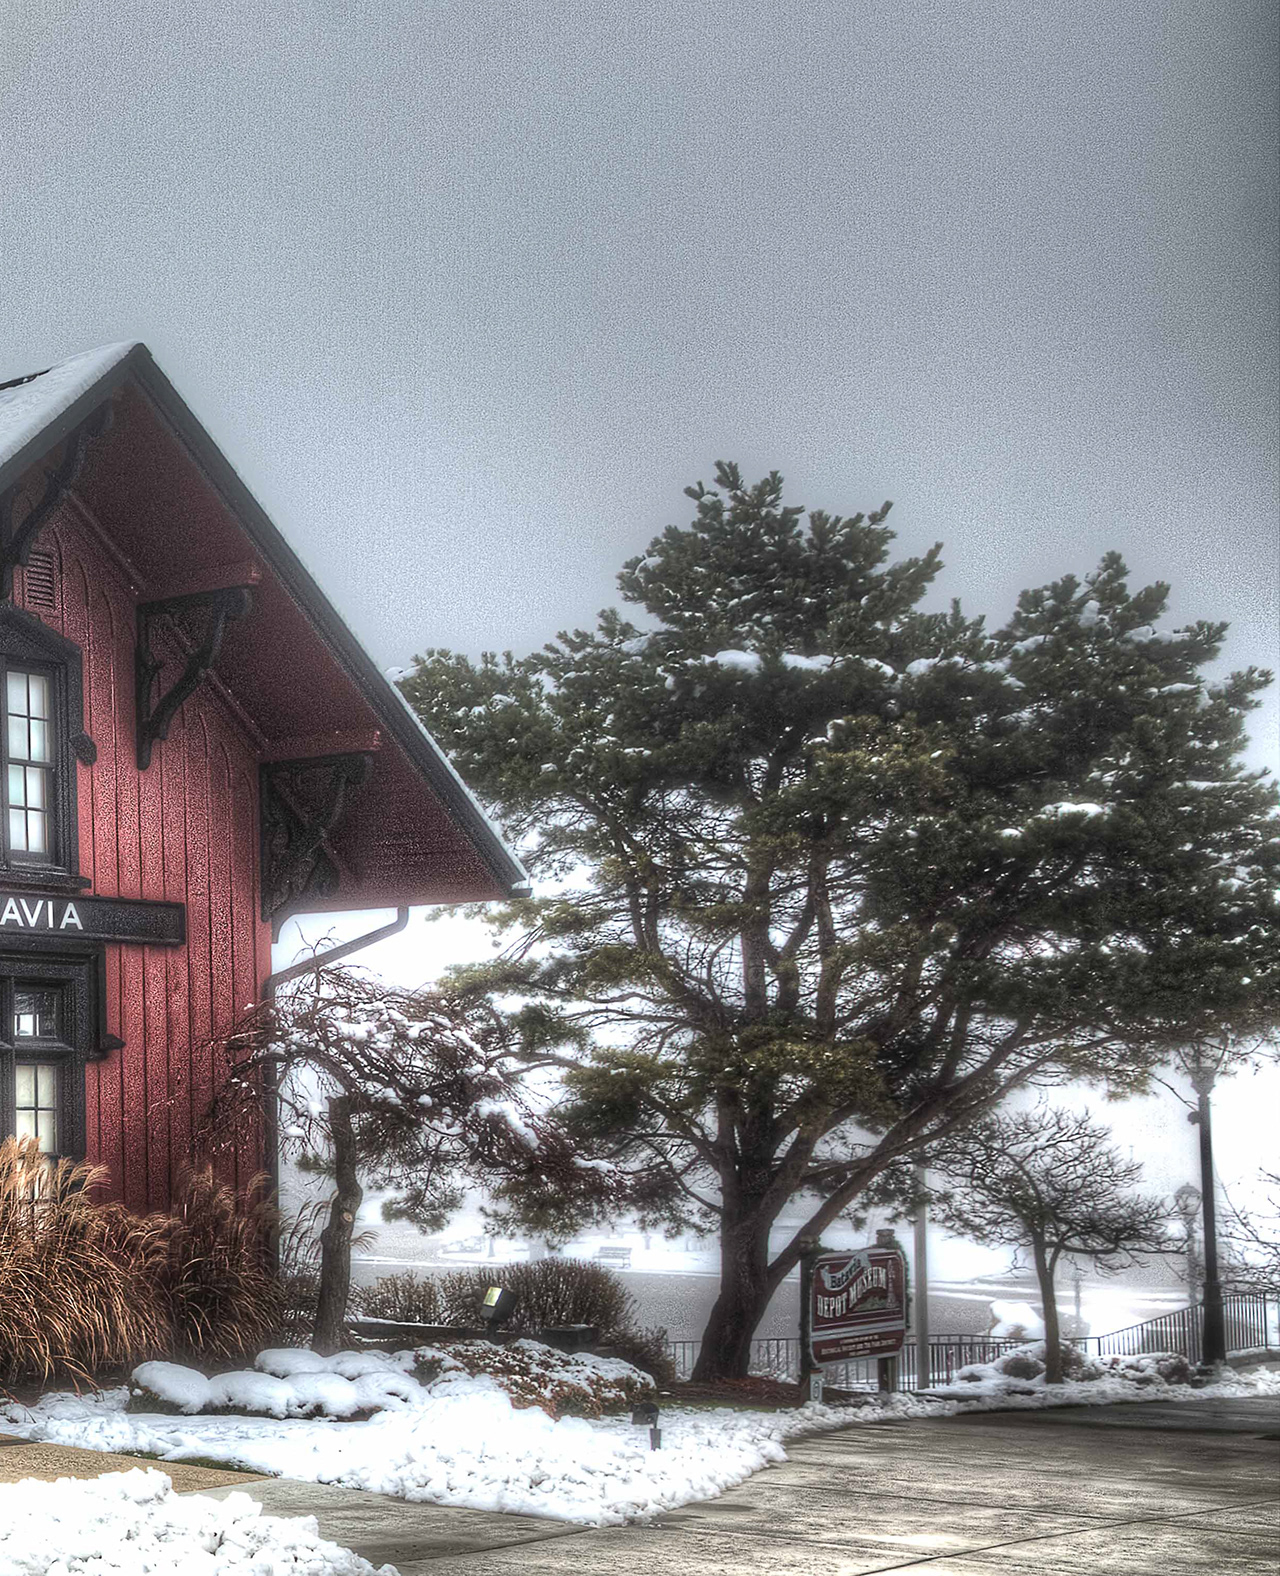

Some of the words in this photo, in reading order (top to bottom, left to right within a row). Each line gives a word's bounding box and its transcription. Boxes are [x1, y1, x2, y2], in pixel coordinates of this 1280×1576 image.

[816, 1292, 848, 1318] DEPOT
[848, 1266, 887, 1308] MUSEUM
[830, 1257, 861, 1289] Batavia
